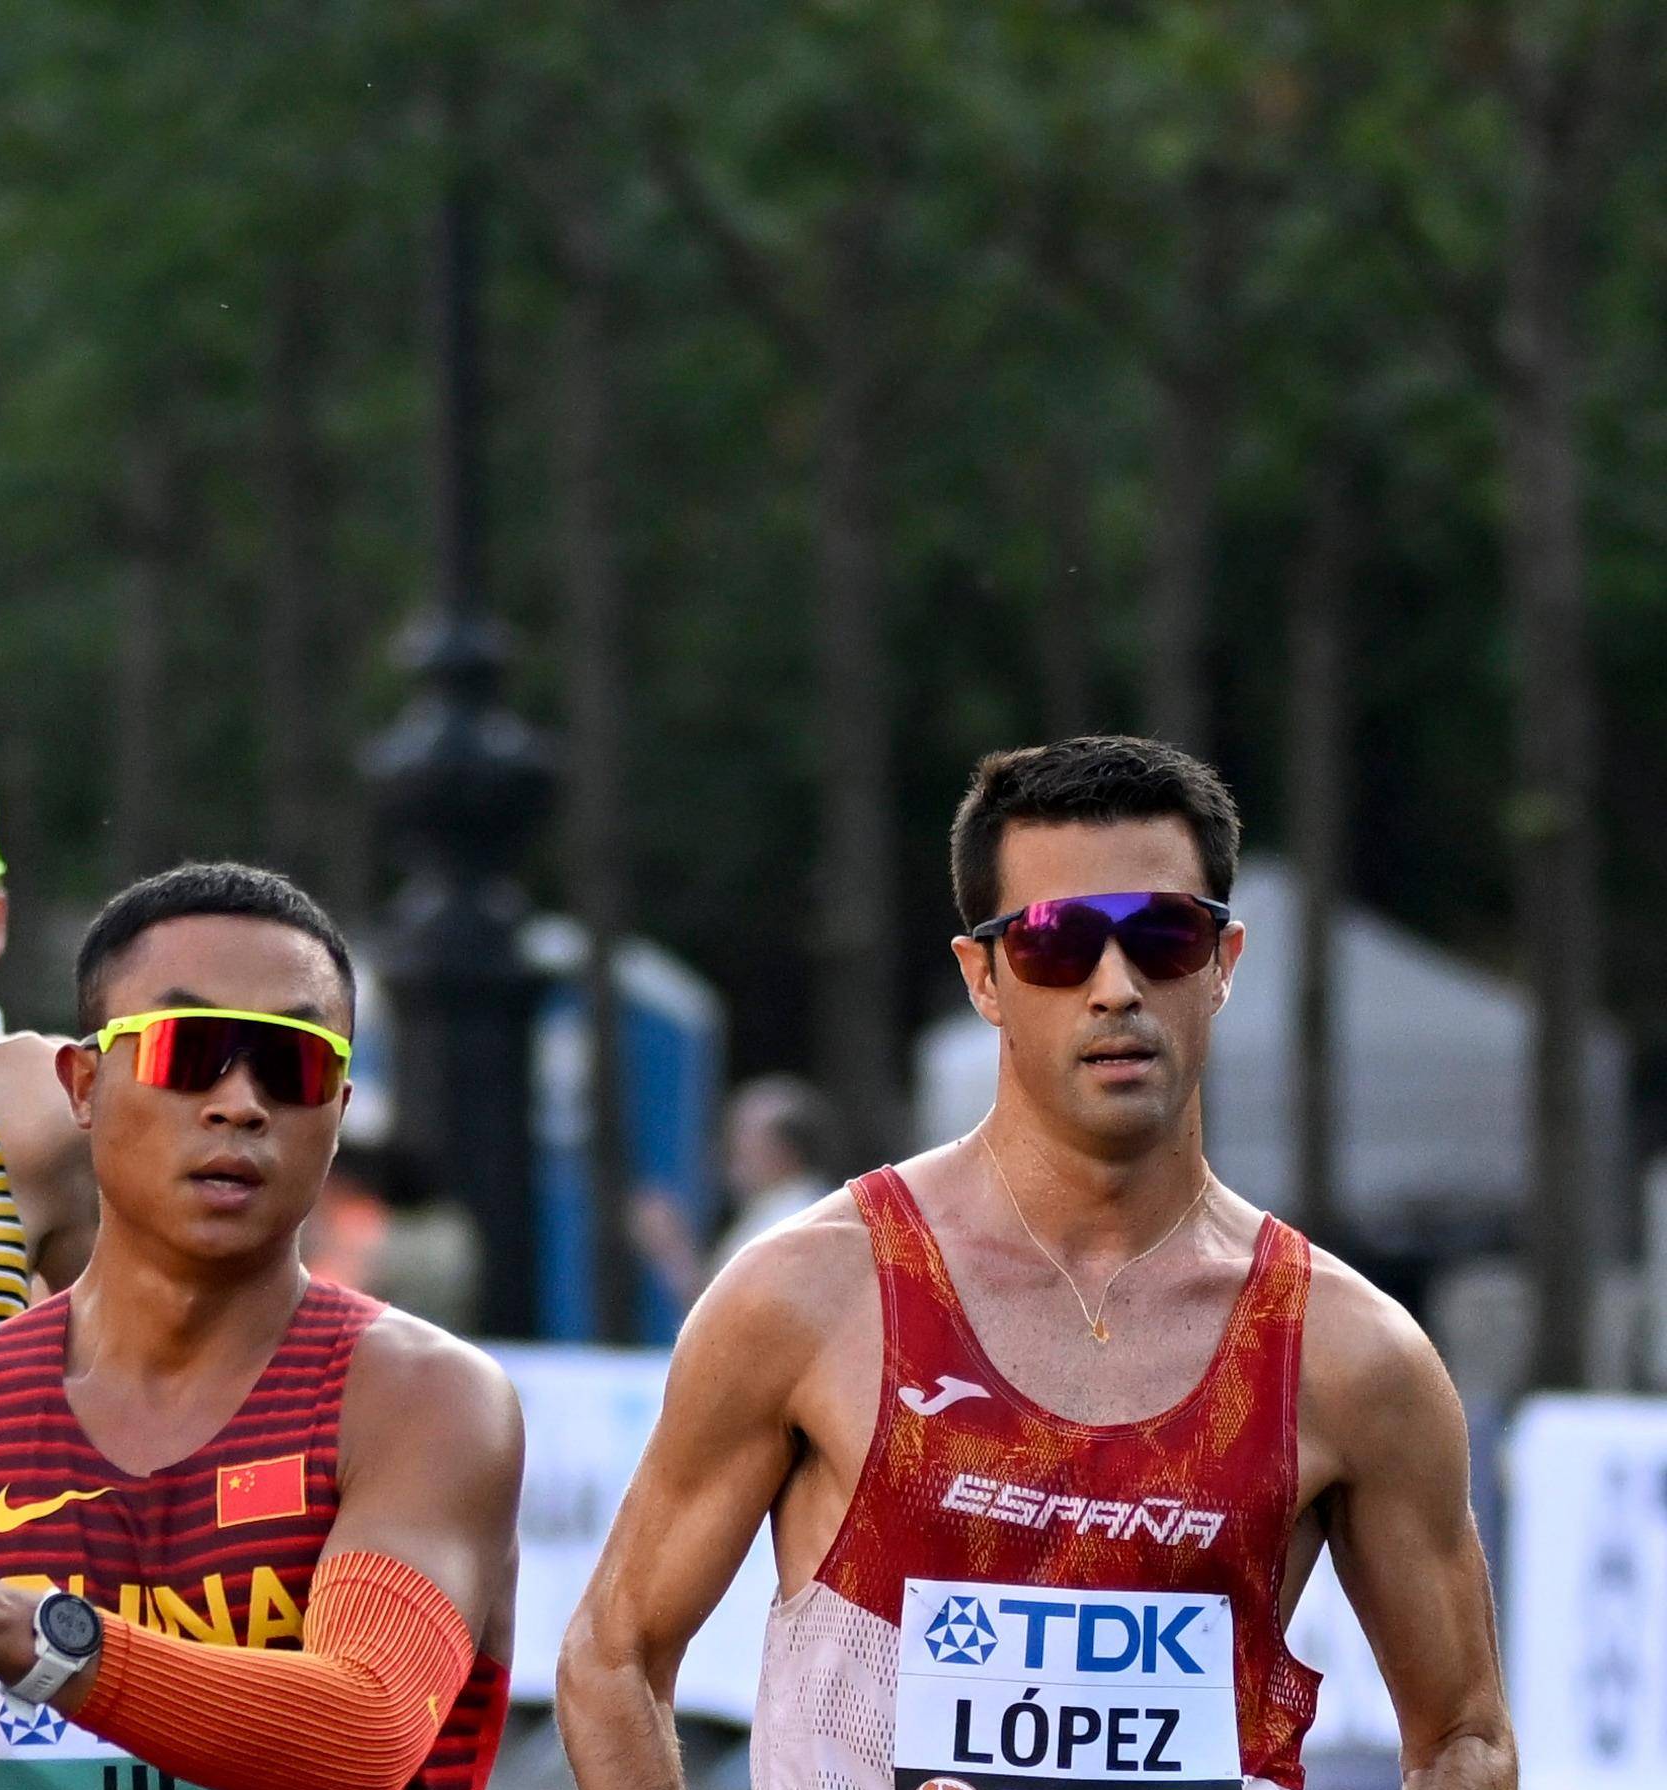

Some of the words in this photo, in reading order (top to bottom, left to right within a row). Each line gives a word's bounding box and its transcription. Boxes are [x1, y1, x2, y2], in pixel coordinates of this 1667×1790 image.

[939, 1472, 1225, 1550] ESPAÑA
[999, 1598, 1207, 1675] TDK
[953, 1688, 1183, 1773] LÓPEZ
